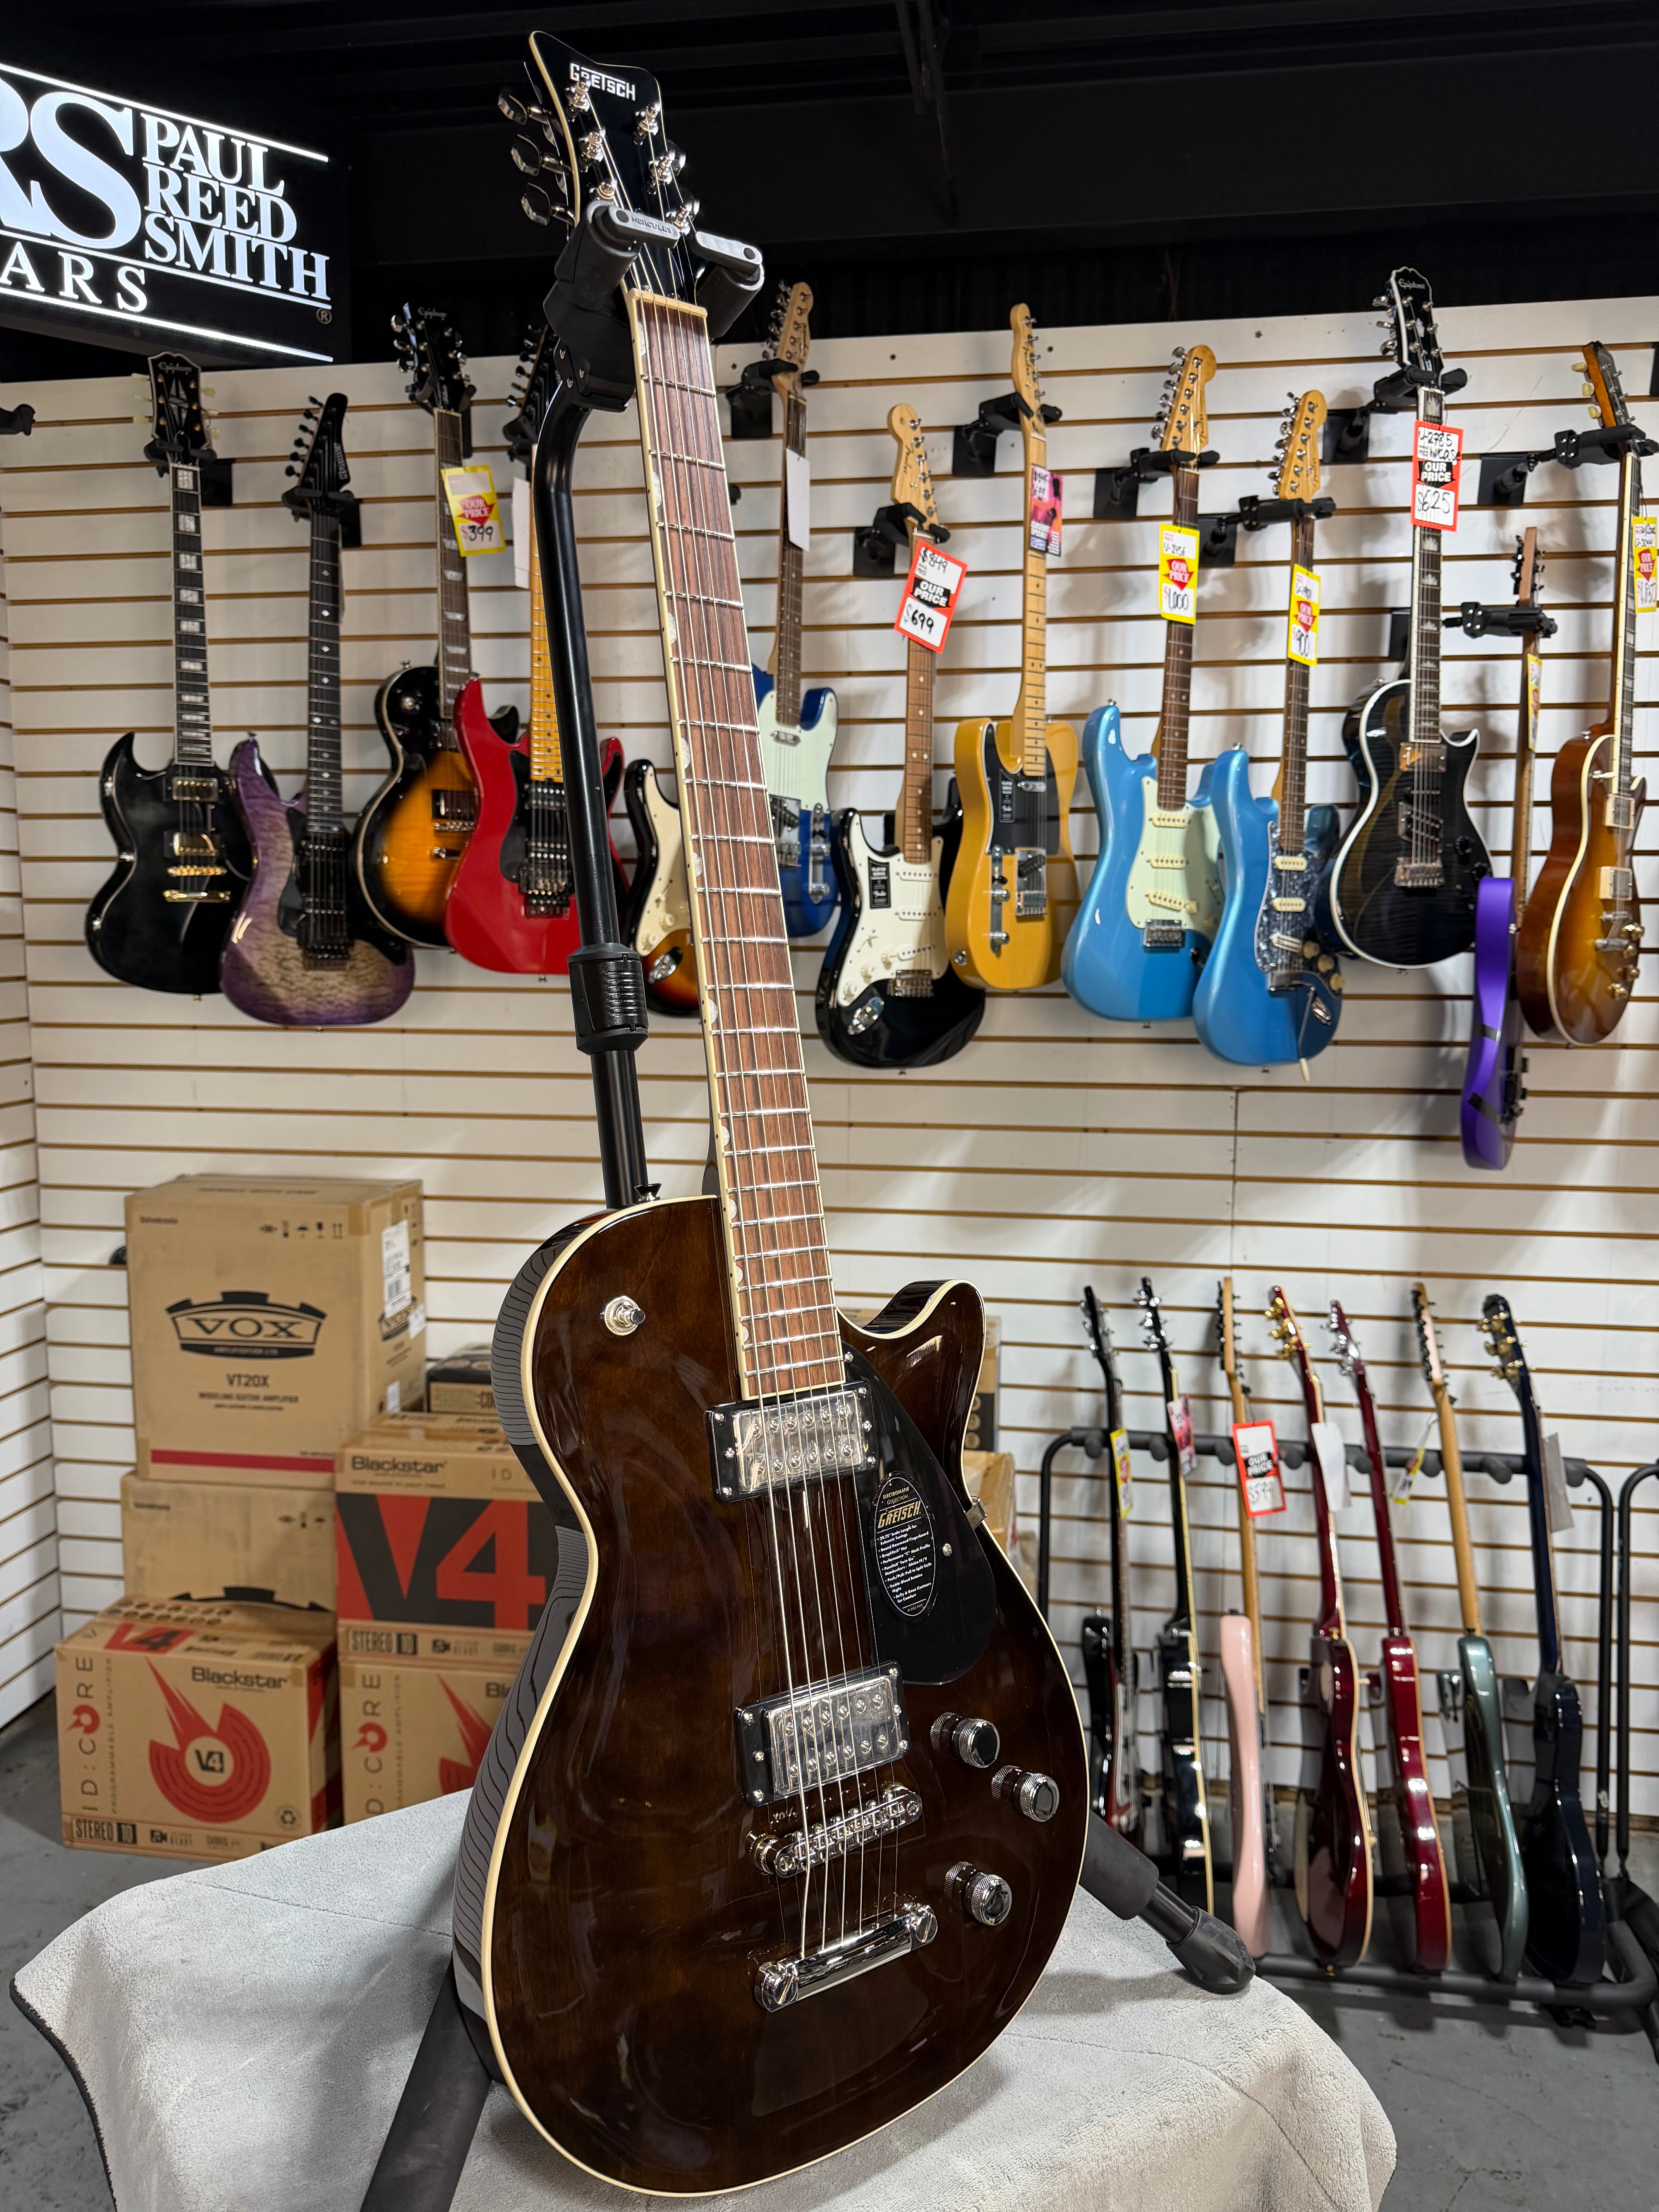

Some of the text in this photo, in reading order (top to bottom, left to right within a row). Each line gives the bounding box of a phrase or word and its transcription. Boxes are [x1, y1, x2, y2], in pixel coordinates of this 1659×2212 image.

[570, 63, 635, 101] GRETSCH
[141, 112, 285, 198] PAUL
[143, 162, 297, 243] REED
[631, 215, 673, 234] HERCULES
[144, 213, 332, 301] SMITH
[1424, 461, 1447, 472] OUR
[1421, 471, 1452, 482] PRICE
[1417, 489, 1450, 514] $625
[464, 507, 490, 519] PRICE
[461, 525, 493, 542] $399
[1171, 560, 1187, 572] OUR
[1169, 570, 1190, 583] PRICE
[920, 580, 945, 596] OUR
[913, 588, 948, 607] PRICE
[904, 604, 934, 635] $699
[1297, 613, 1314, 627] PRICE
[188, 1318, 303, 1339] VOX
[227, 1373, 270, 1388] VT20X
[351, 1455, 444, 1474] Blackstar
[1247, 1459, 1274, 1478] PRICE
[883, 1487, 910, 1499] ELECTROMATIC
[886, 1494, 908, 1505] COLLECTION
[878, 1500, 921, 1529] GRETSCH
[900, 1525, 912, 1533] Length
[892, 1538, 909, 1548] Rosewood
[909, 1531, 929, 1542] Fingerboard
[883, 1554, 904, 1565] Performance
[885, 1566, 905, 1576] Humbuckers
[903, 1593, 916, 1601] Comfort
[351, 1630, 393, 1653] STEREO
[192, 1666, 287, 1689] Blackstar
[194, 1749, 225, 1773] V4
[76, 1820, 114, 1842] STEREO
